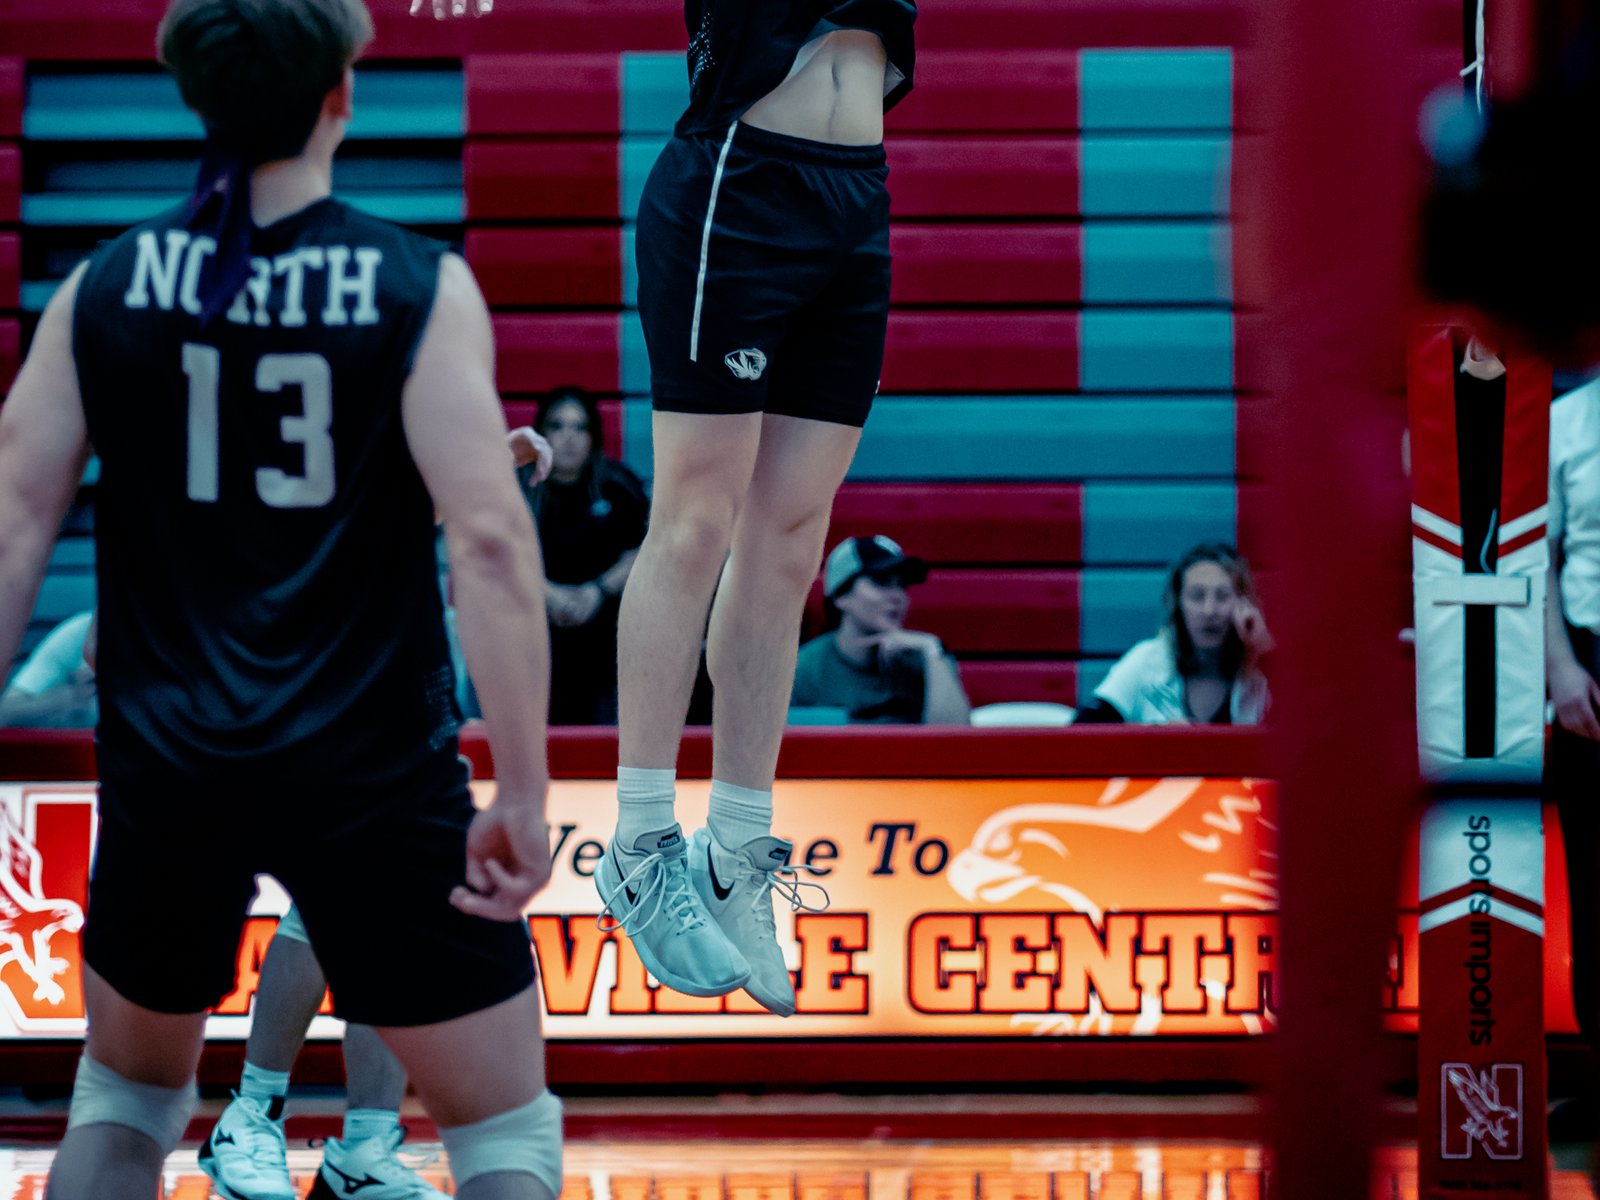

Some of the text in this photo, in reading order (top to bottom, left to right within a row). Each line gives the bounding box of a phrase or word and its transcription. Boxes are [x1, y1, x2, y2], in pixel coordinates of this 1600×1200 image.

[181, 342, 336, 508] 13
[867, 822, 950, 876] To
[907, 911, 1419, 1016] CENTR
[1463, 815, 1496, 1046] sports imports
